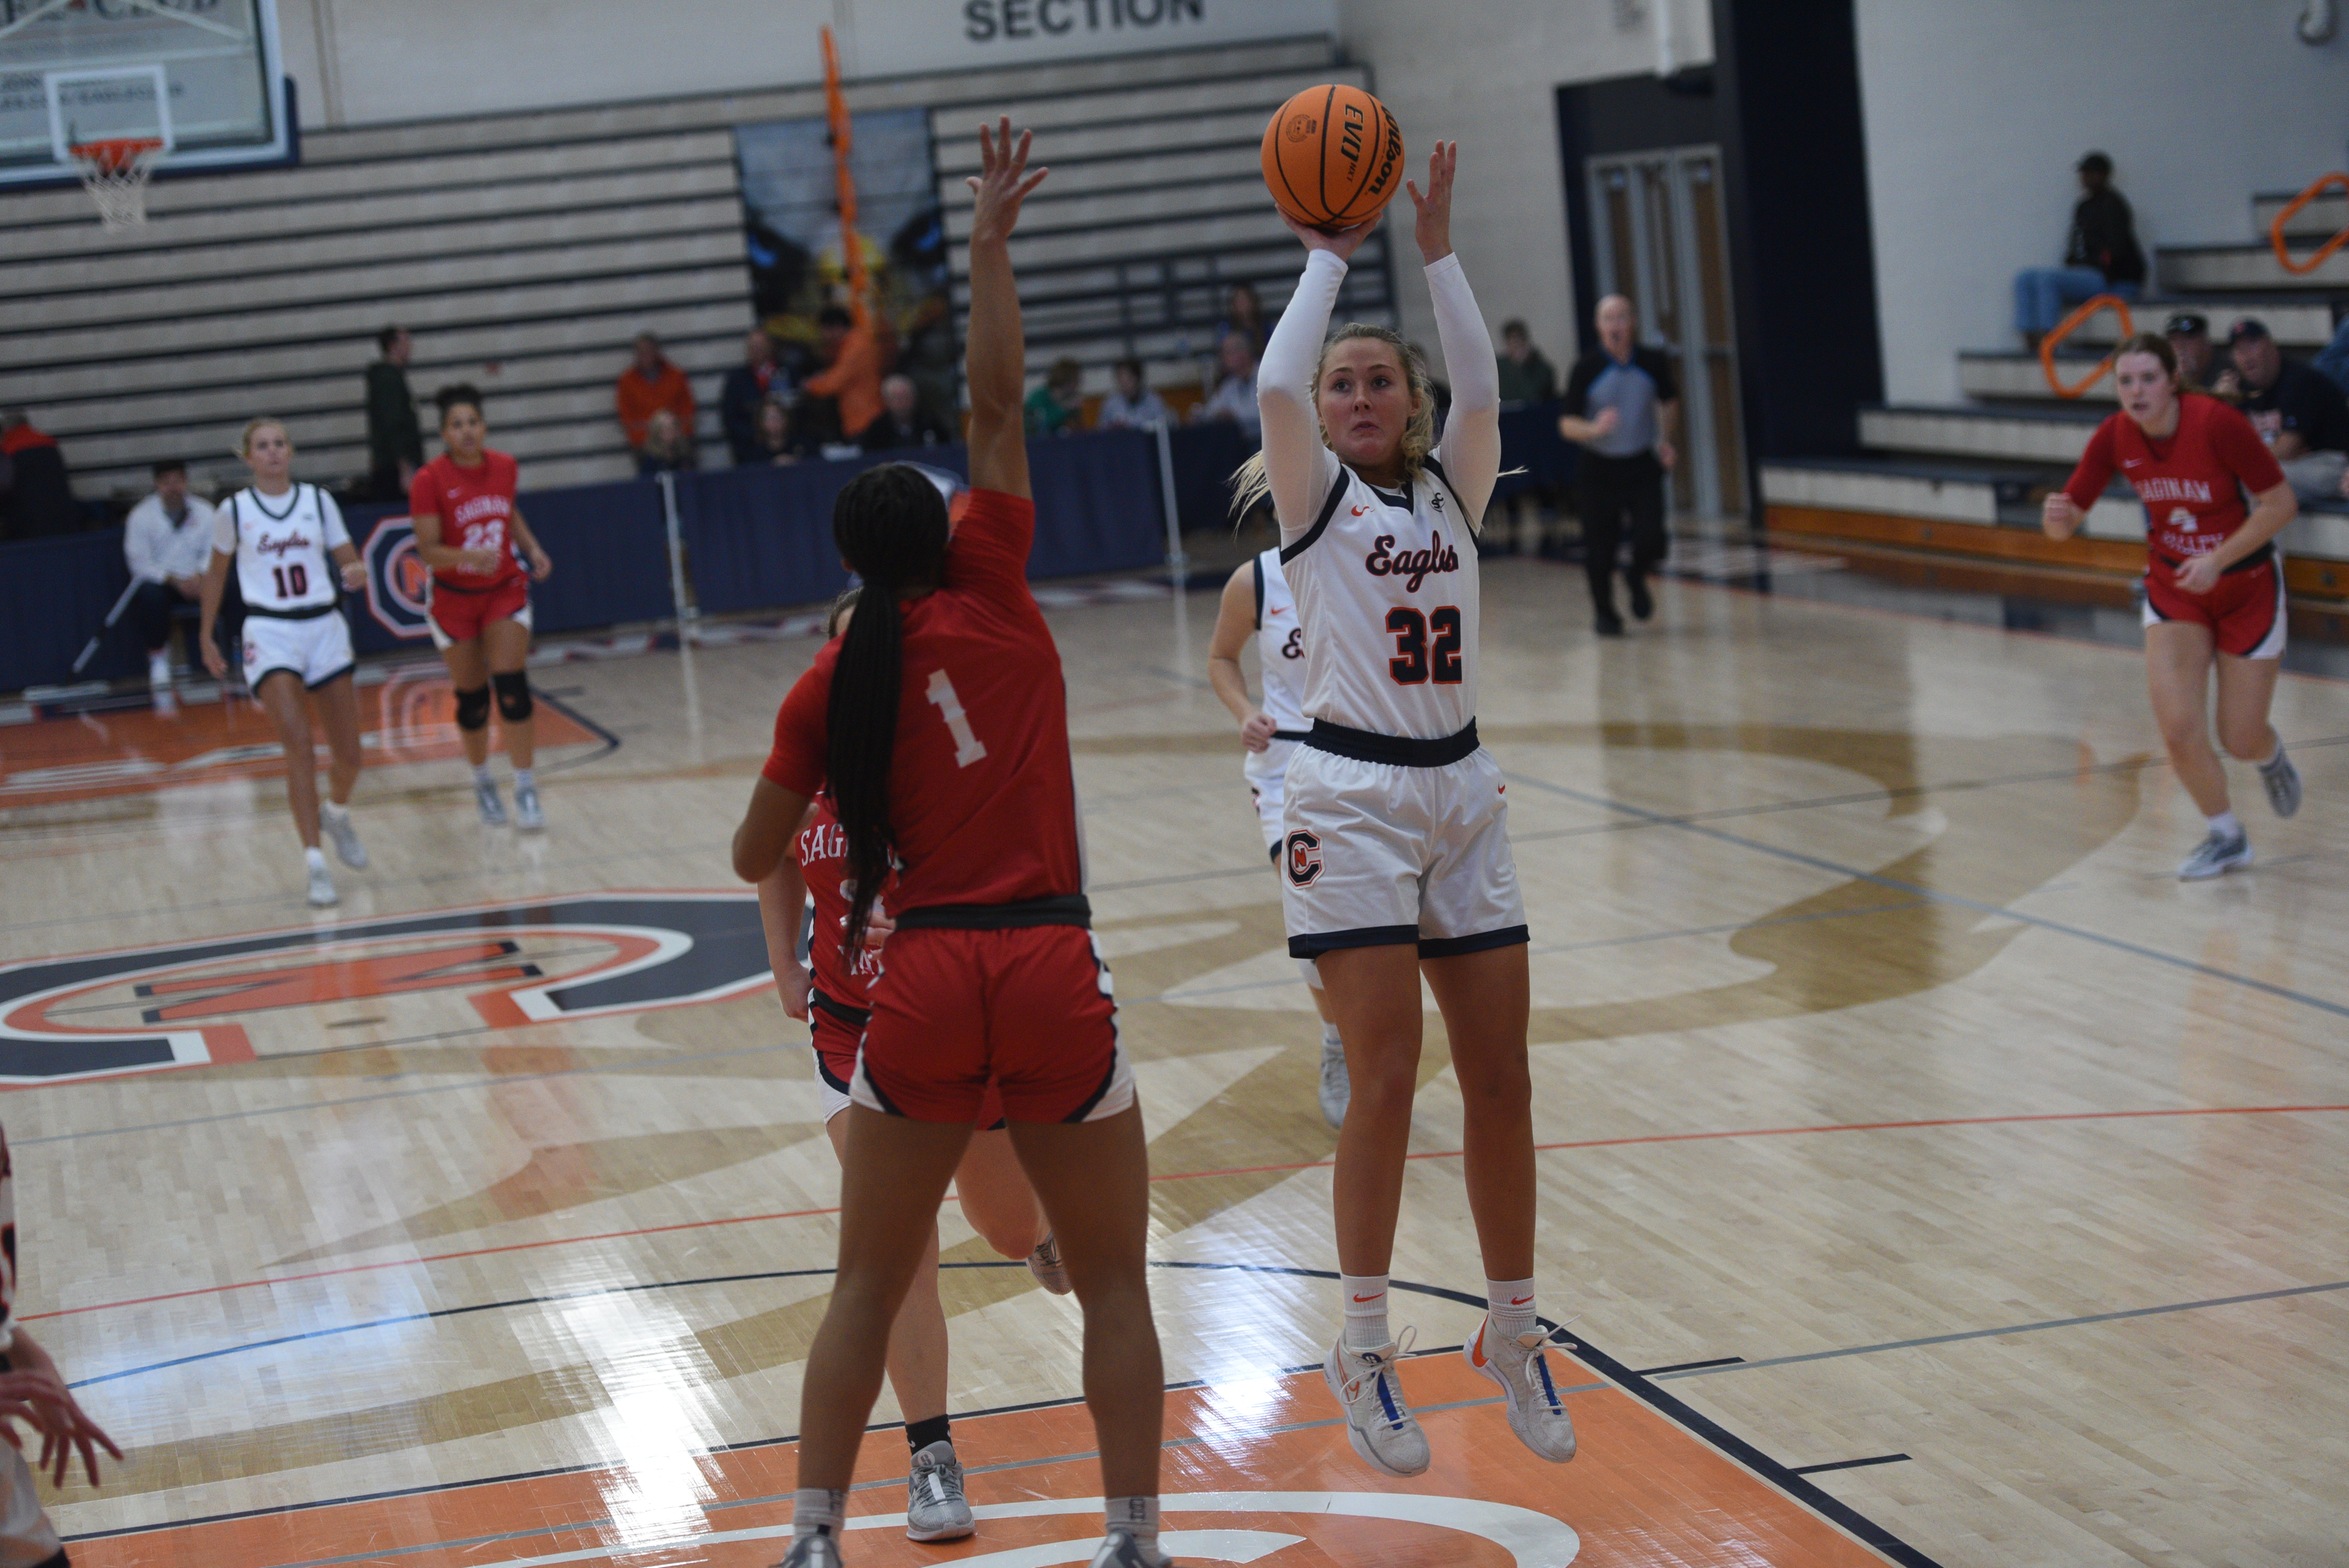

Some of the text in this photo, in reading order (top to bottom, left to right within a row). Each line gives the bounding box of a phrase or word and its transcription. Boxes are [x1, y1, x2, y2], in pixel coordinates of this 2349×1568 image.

[963, 0, 1204, 42] SECTION
[273, 564, 308, 600] 10
[1385, 605, 1463, 686] 32
[924, 668, 988, 769] 1
[800, 823, 849, 867] SAG
